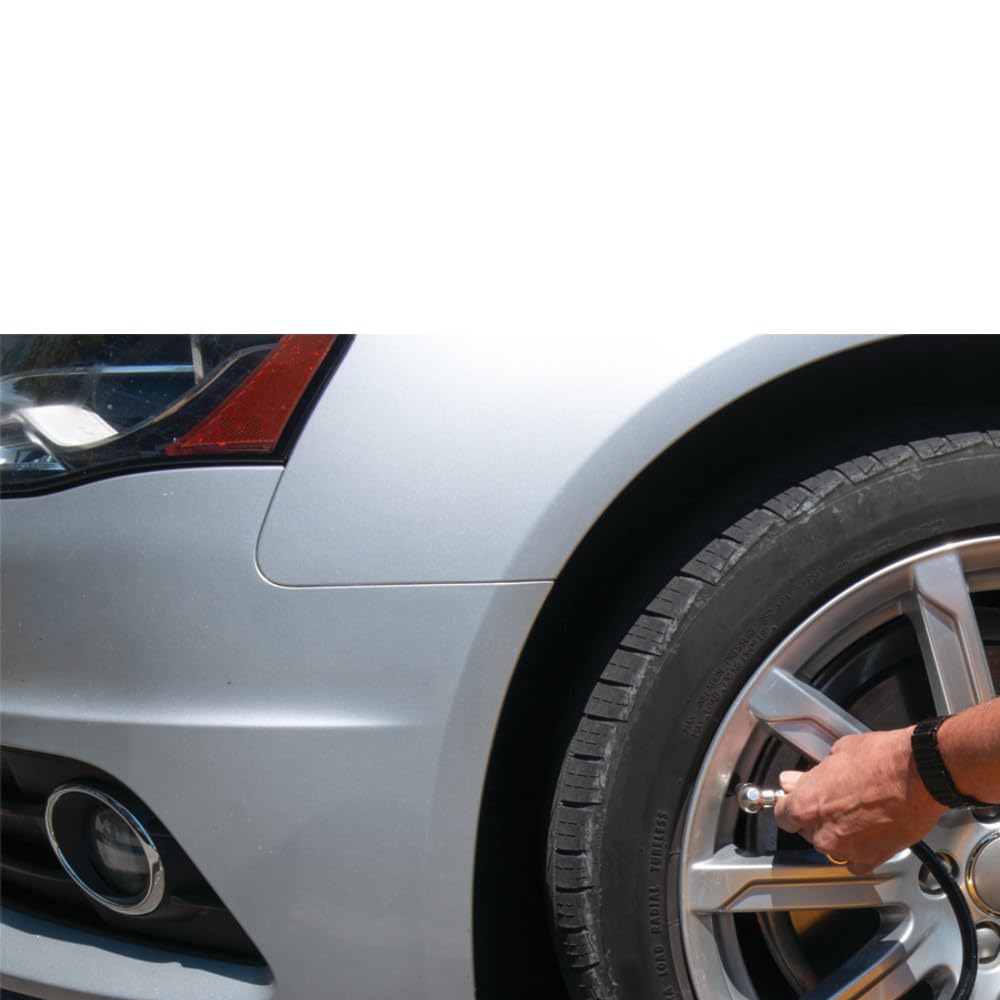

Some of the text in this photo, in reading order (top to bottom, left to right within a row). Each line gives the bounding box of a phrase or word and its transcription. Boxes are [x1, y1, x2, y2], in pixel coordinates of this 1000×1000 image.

[650, 811, 668, 873] TUBELESS
[649, 886, 664, 936] RADIAL
[652, 944, 671, 978] LOAD
